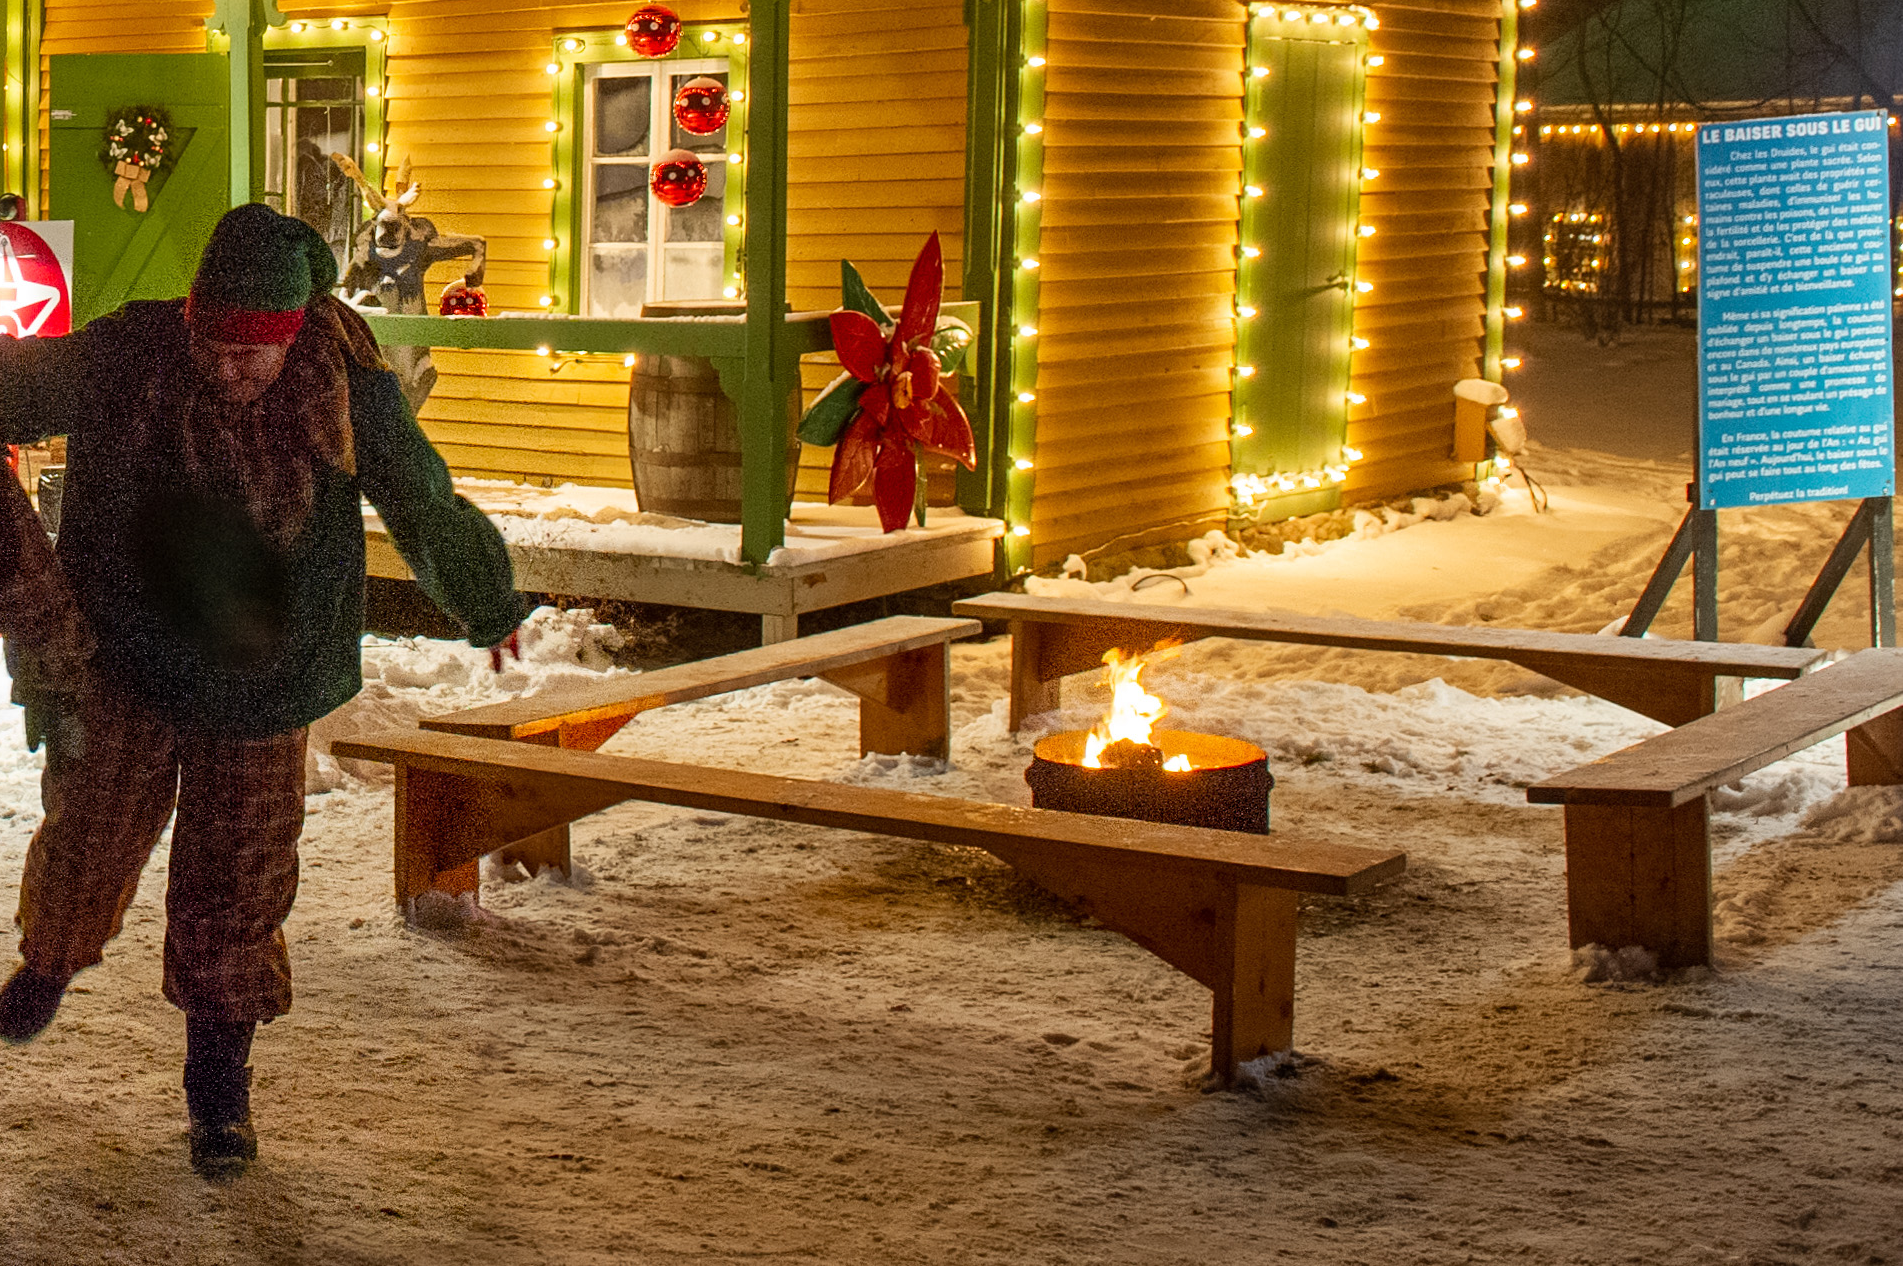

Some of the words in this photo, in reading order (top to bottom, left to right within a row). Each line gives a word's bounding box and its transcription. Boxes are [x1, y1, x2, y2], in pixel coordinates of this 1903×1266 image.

[1702, 130, 1719, 145] LE
[1724, 124, 1782, 143] BAISER
[1785, 120, 1828, 137] SOUS
[1832, 118, 1850, 133] LE
[1854, 115, 1881, 131] GUI
